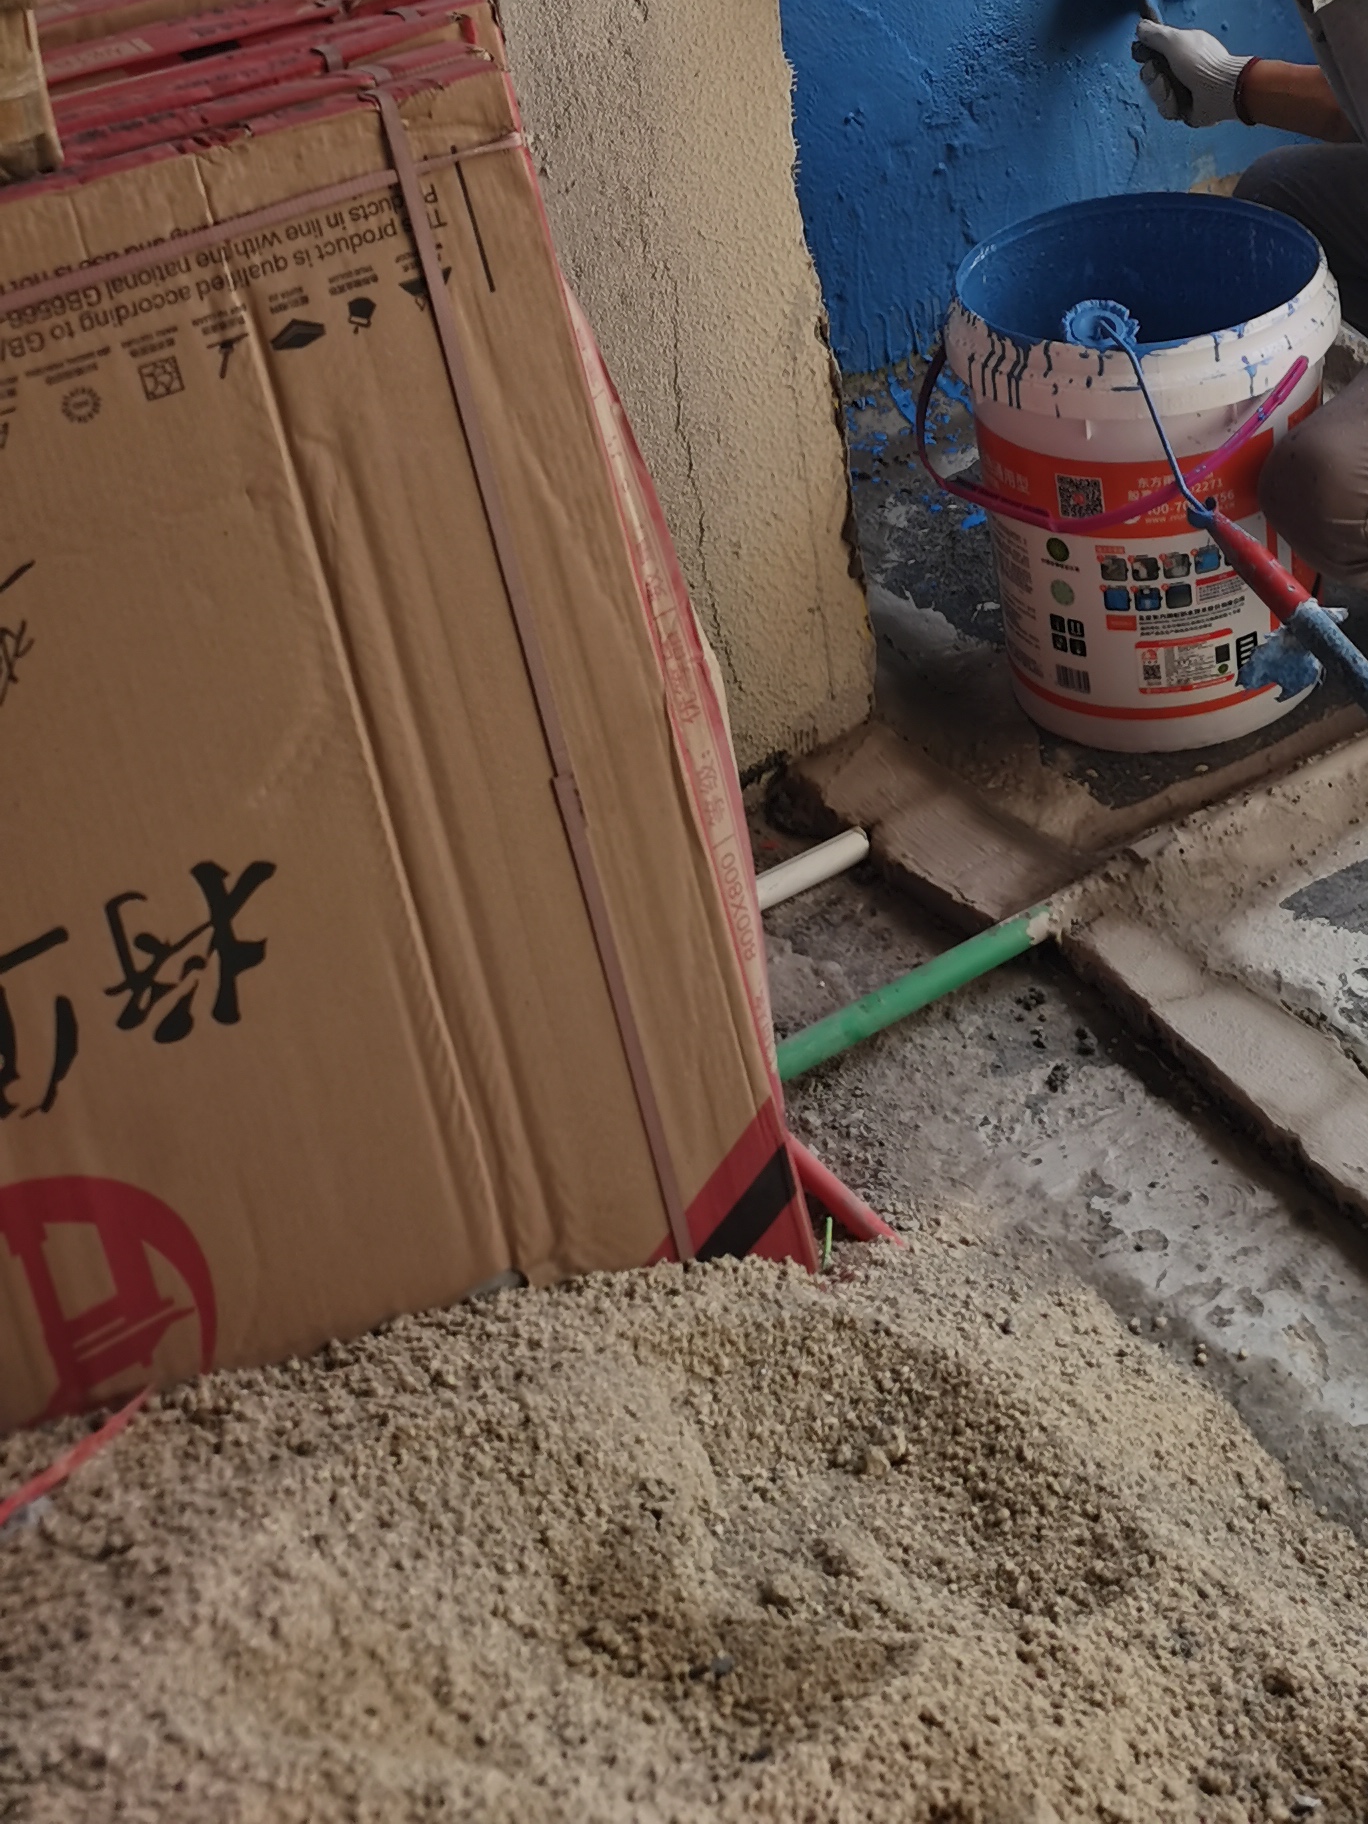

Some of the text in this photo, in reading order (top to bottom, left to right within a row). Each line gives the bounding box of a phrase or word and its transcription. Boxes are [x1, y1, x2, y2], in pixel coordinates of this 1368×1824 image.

[349, 183, 438, 222] Pducts
[285, 217, 324, 239] line
[325, 210, 345, 232] in
[196, 239, 231, 267] the
[234, 229, 282, 260] with
[317, 218, 397, 261] product
[294, 247, 314, 268] is
[106, 255, 192, 300] national
[196, 254, 288, 300] qualified
[79, 284, 191, 331] according
[50, 320, 76, 340] to
[721, 852, 757, 961] 800X800
